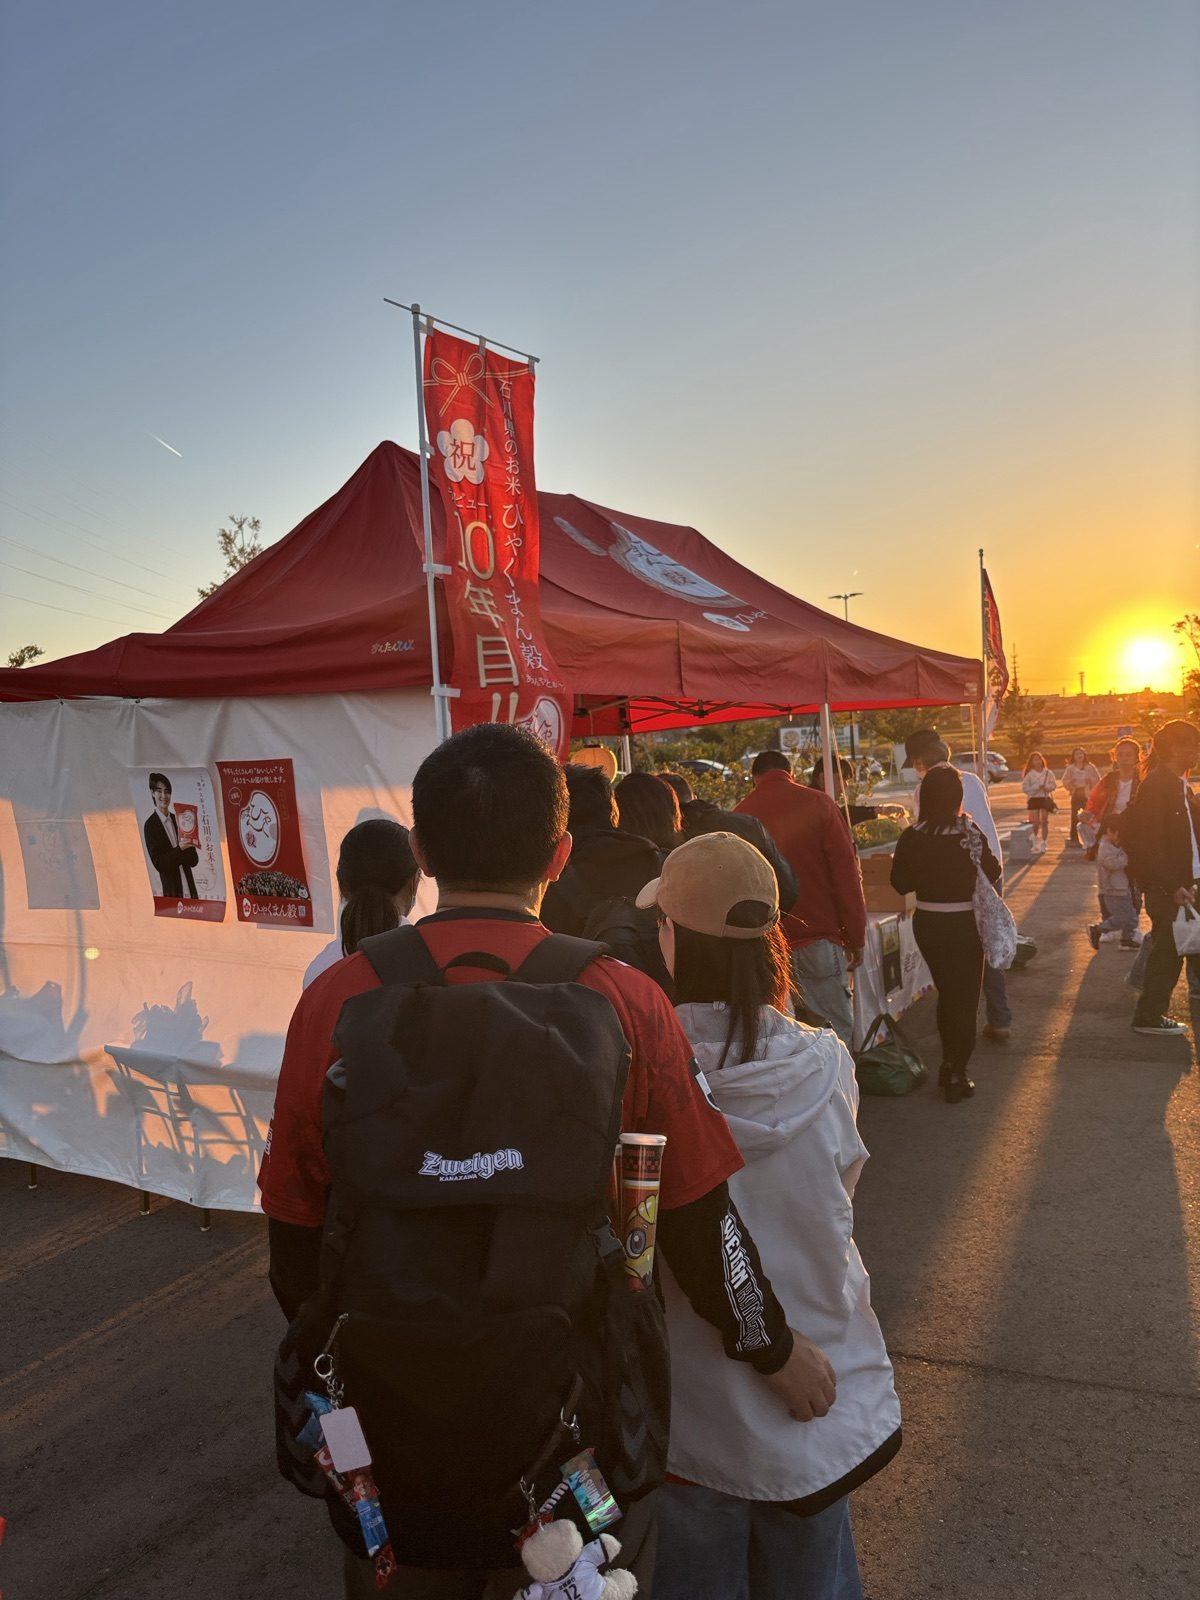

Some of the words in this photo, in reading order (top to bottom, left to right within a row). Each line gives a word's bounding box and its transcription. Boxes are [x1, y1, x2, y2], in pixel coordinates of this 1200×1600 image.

[450, 440, 476, 472] 祝
[502, 503, 548, 672] ひゃくまん穀
[252, 902, 298, 918] ひゃくまん穀
[417, 1148, 525, 1180] Zweigen
[439, 1173, 478, 1182] KANAZAWA
